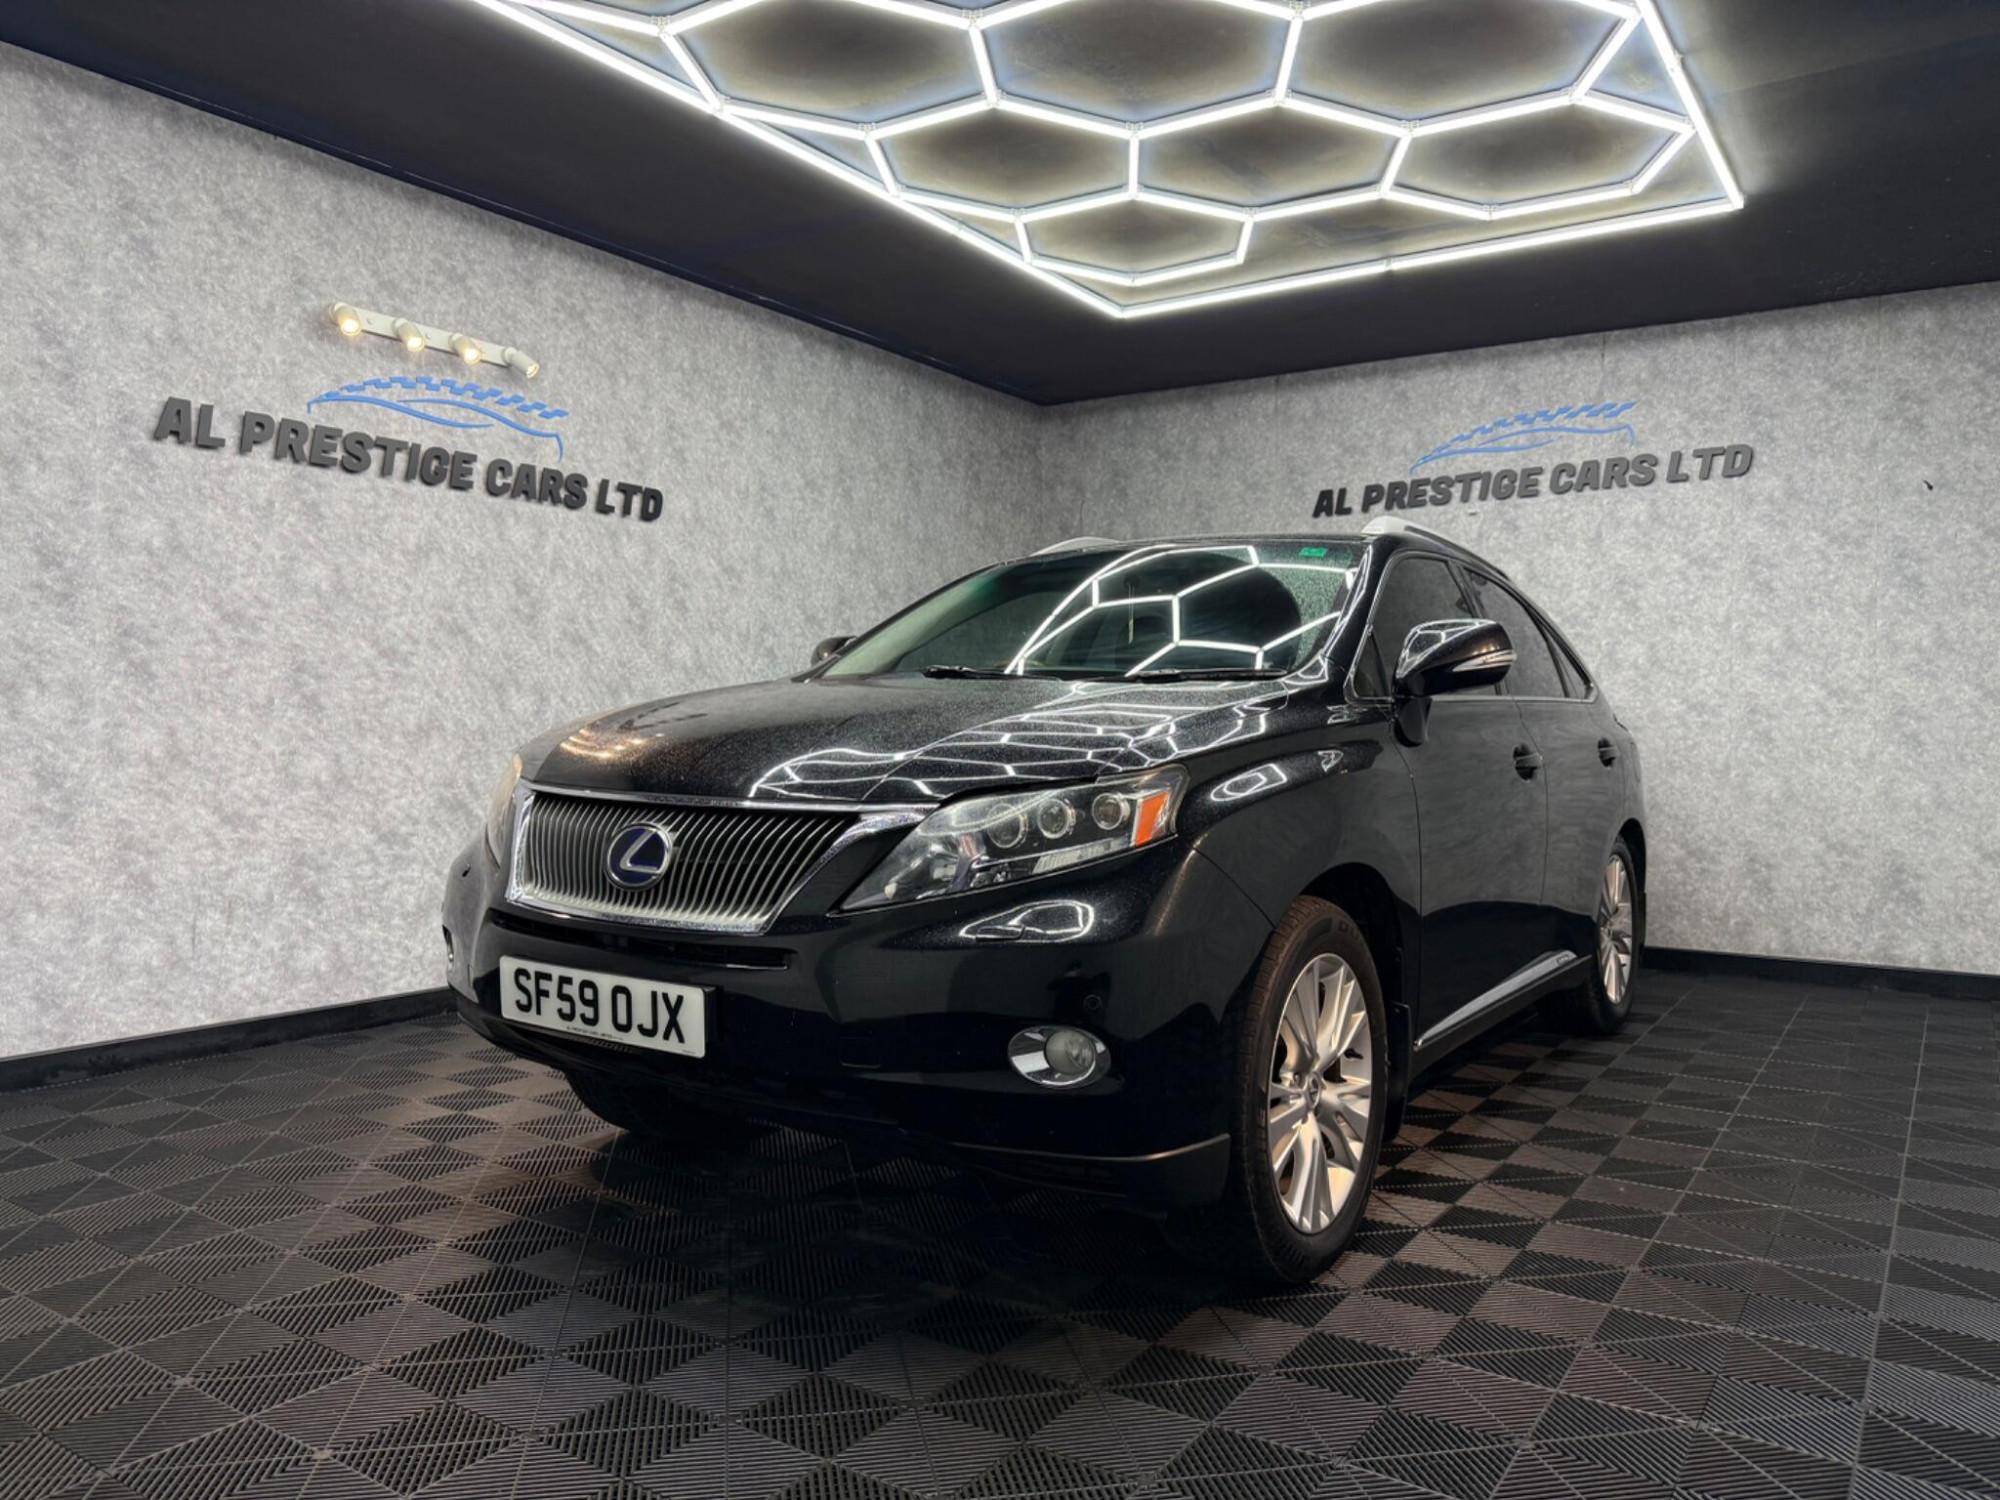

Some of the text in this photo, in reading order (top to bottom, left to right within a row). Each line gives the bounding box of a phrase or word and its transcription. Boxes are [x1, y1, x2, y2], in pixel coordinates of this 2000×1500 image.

[153, 396, 665, 522] AL PRESTIGE CARS LTD
[1312, 443, 1754, 518] AL PRESTIGE CARS LTD
[514, 967, 685, 1044] SF59 OJX
